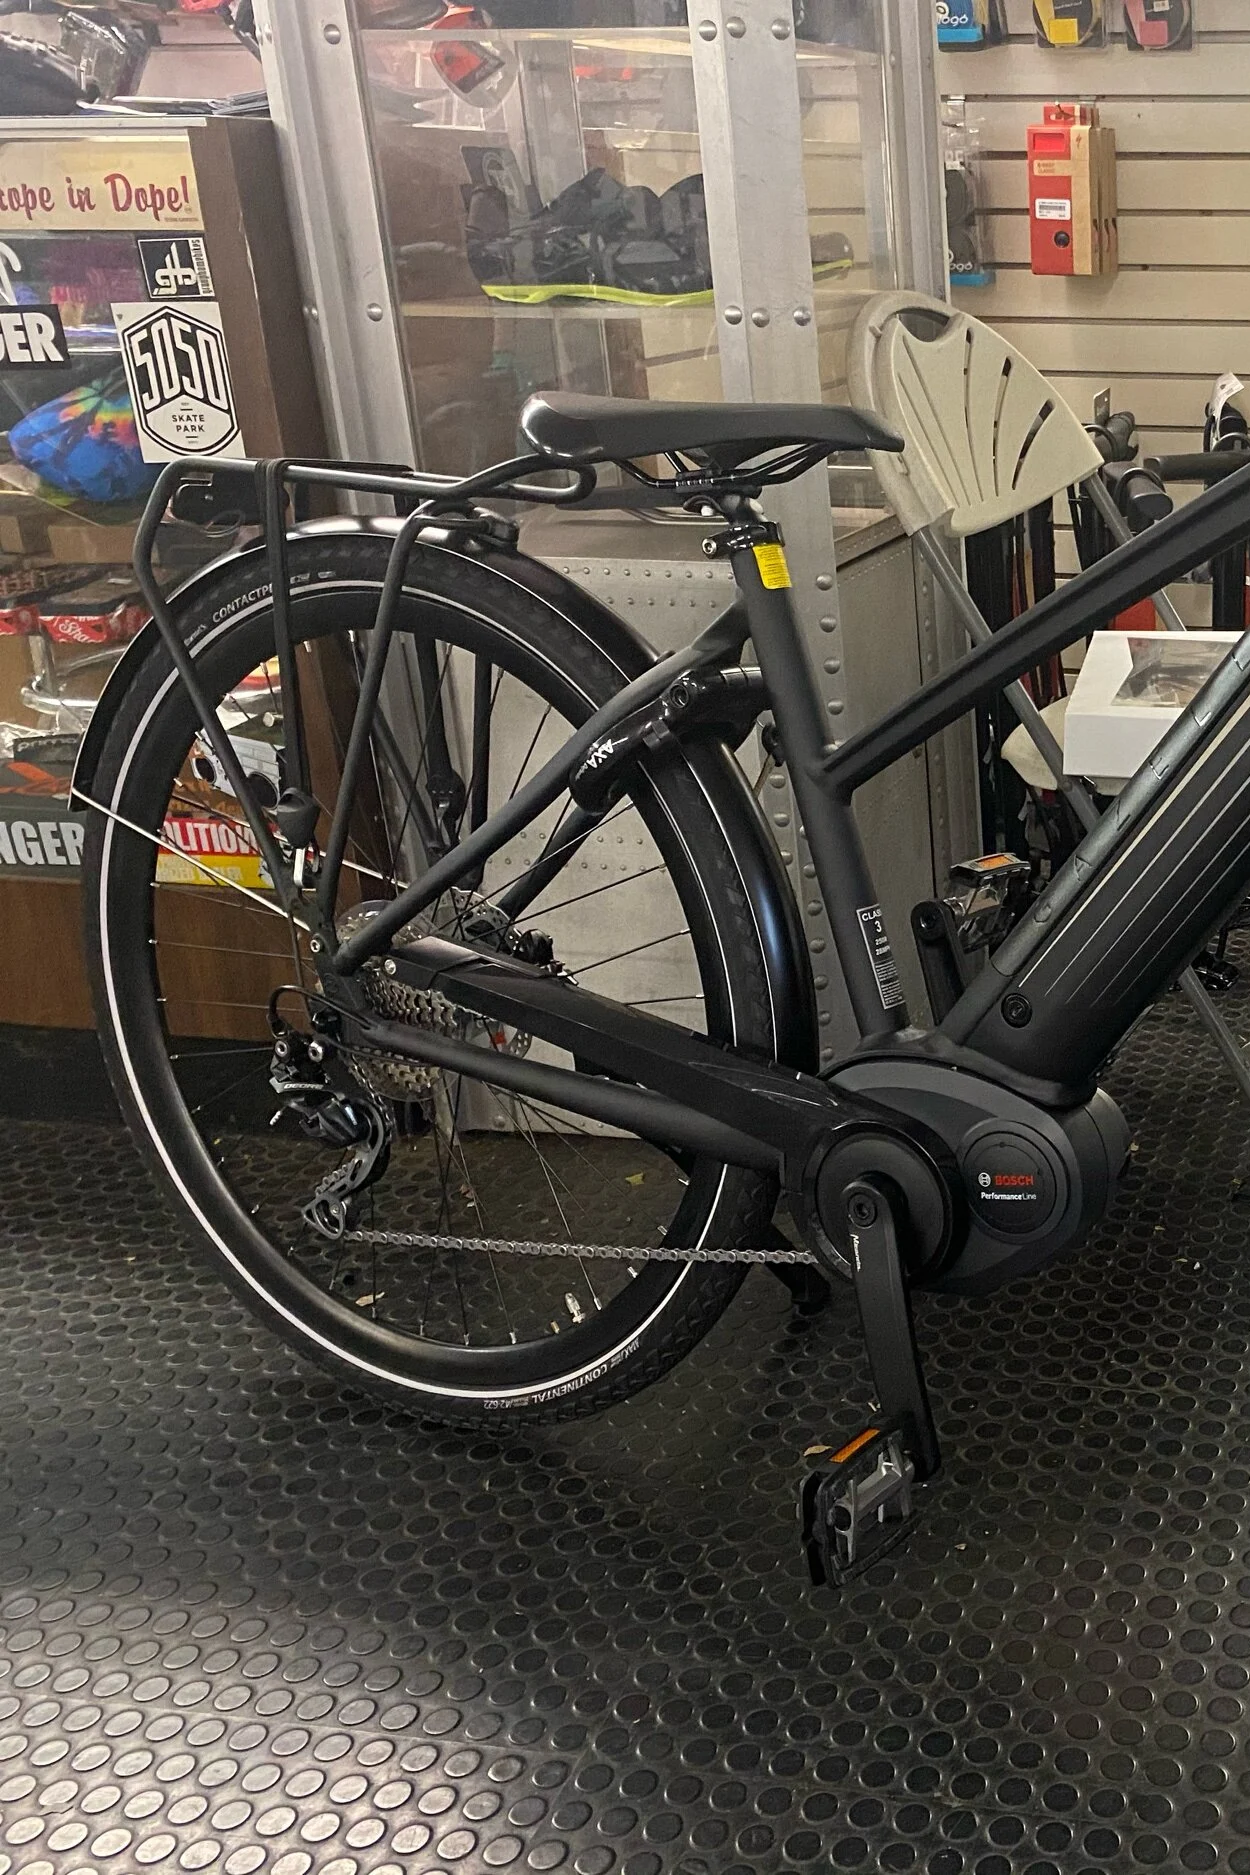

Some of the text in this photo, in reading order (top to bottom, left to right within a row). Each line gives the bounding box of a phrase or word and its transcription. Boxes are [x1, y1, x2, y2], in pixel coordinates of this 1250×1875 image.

[65, 176, 97, 213] in
[103, 172, 190, 222] Dope!
[171, 414, 205, 423] SKATE
[176, 424, 205, 433] PARK
[874, 920, 882, 933] 3
[995, 1174, 1035, 1187] BOSCH
[531, 1363, 608, 1404] CONTINENTAL
